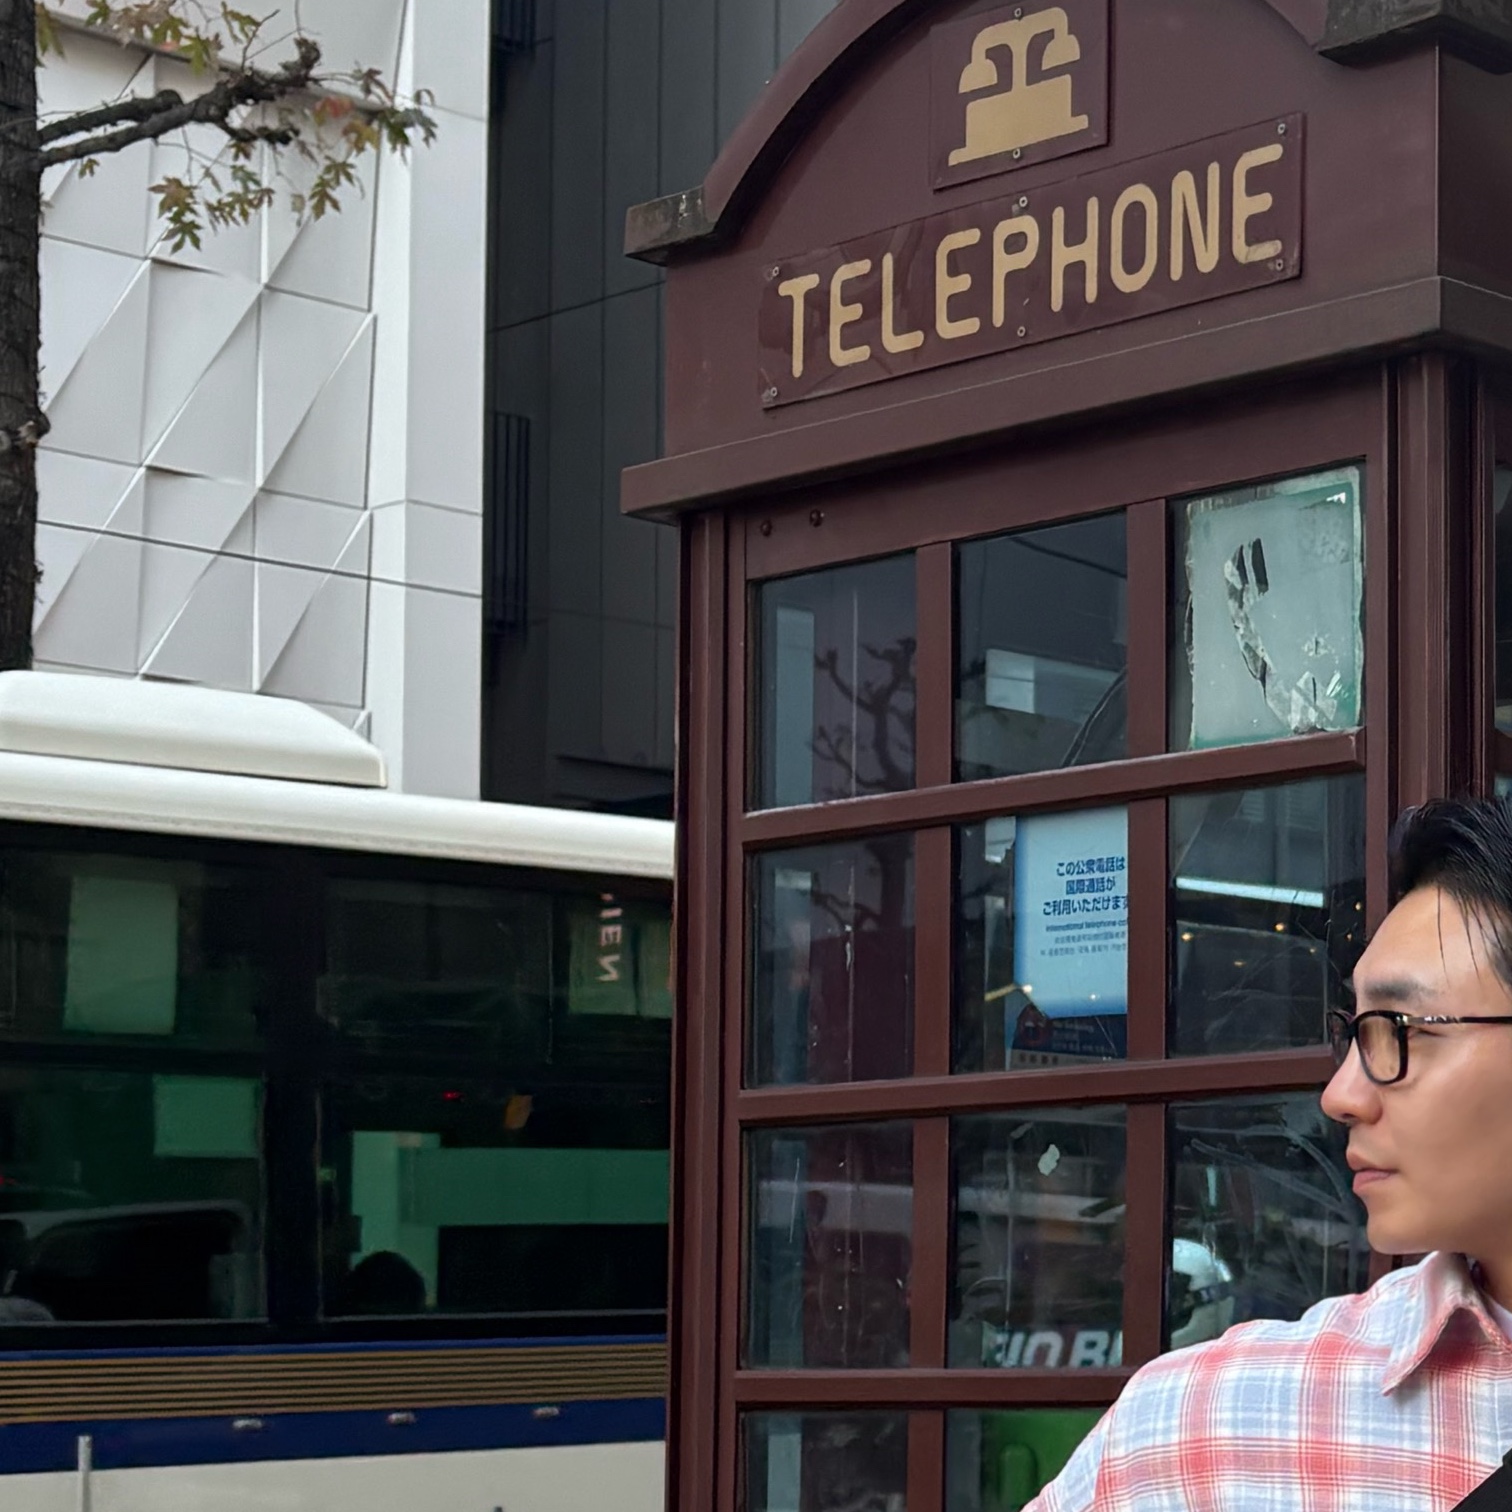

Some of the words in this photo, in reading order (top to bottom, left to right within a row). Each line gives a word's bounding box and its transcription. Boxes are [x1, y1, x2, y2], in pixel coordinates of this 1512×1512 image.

[778, 143, 1284, 378] TELEPHONE
[1056, 857, 1126, 876] この公衆電話は
